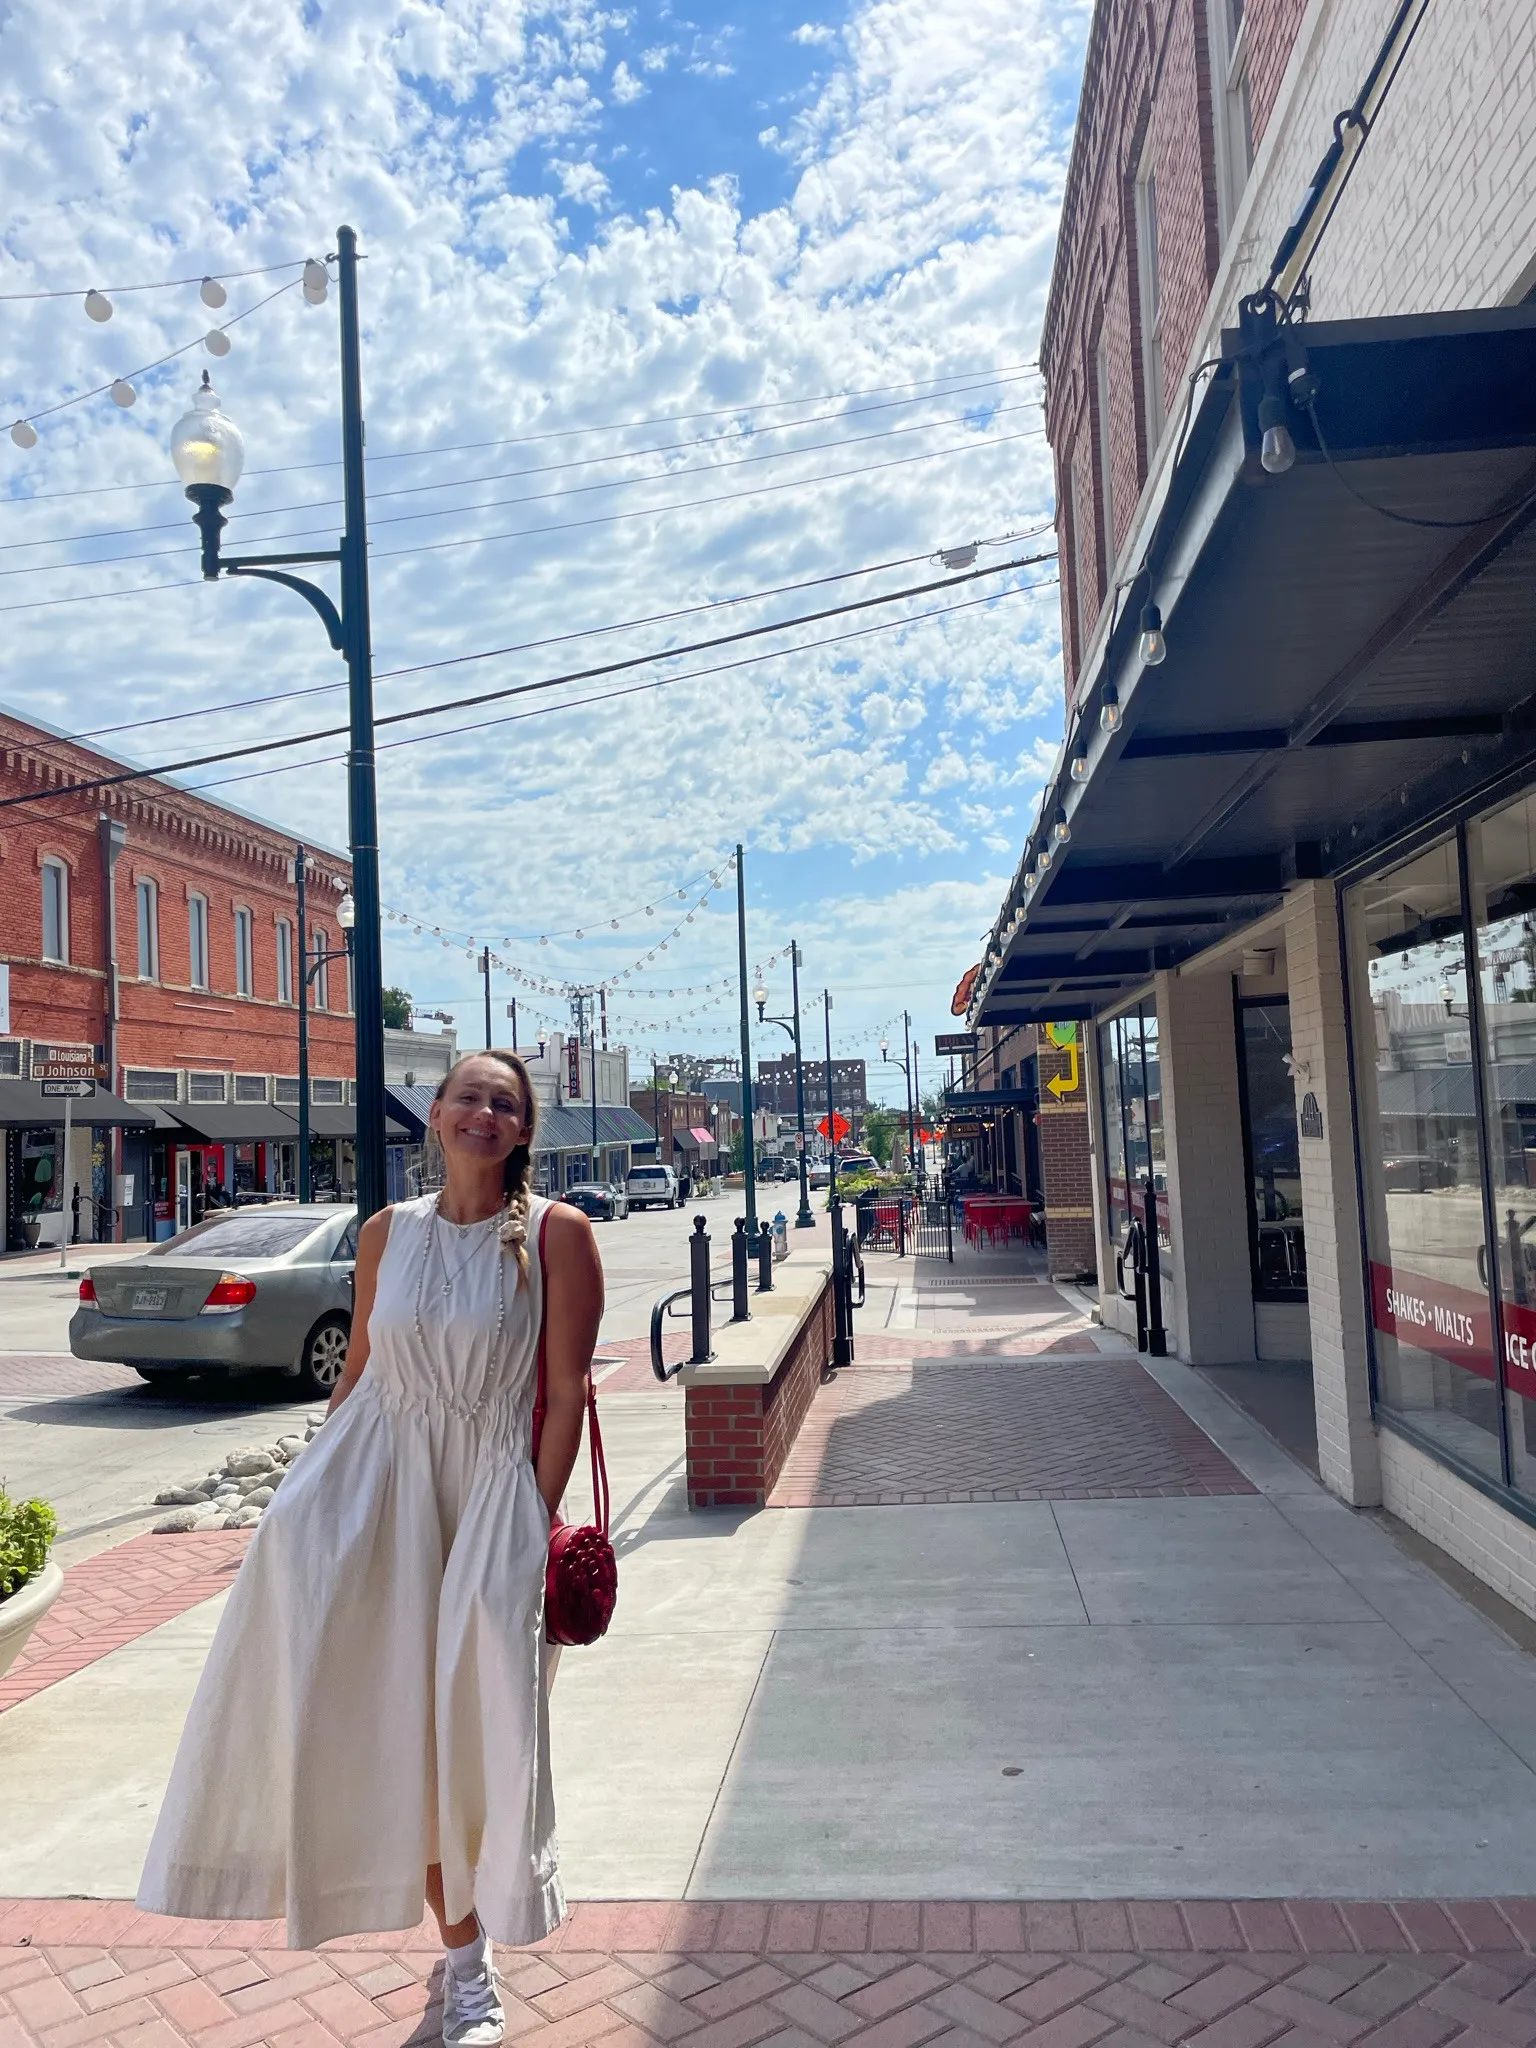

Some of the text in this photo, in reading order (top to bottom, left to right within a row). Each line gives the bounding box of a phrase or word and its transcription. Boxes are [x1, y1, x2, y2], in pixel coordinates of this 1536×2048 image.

[57, 1050, 87, 1062] Louisiana
[47, 1065, 95, 1077] Johnson
[46, 1085, 80, 1093] ONE WAY
[1386, 1288, 1474, 1346] SHAKES MALTS
[1504, 1331, 1529, 1370] ICE
